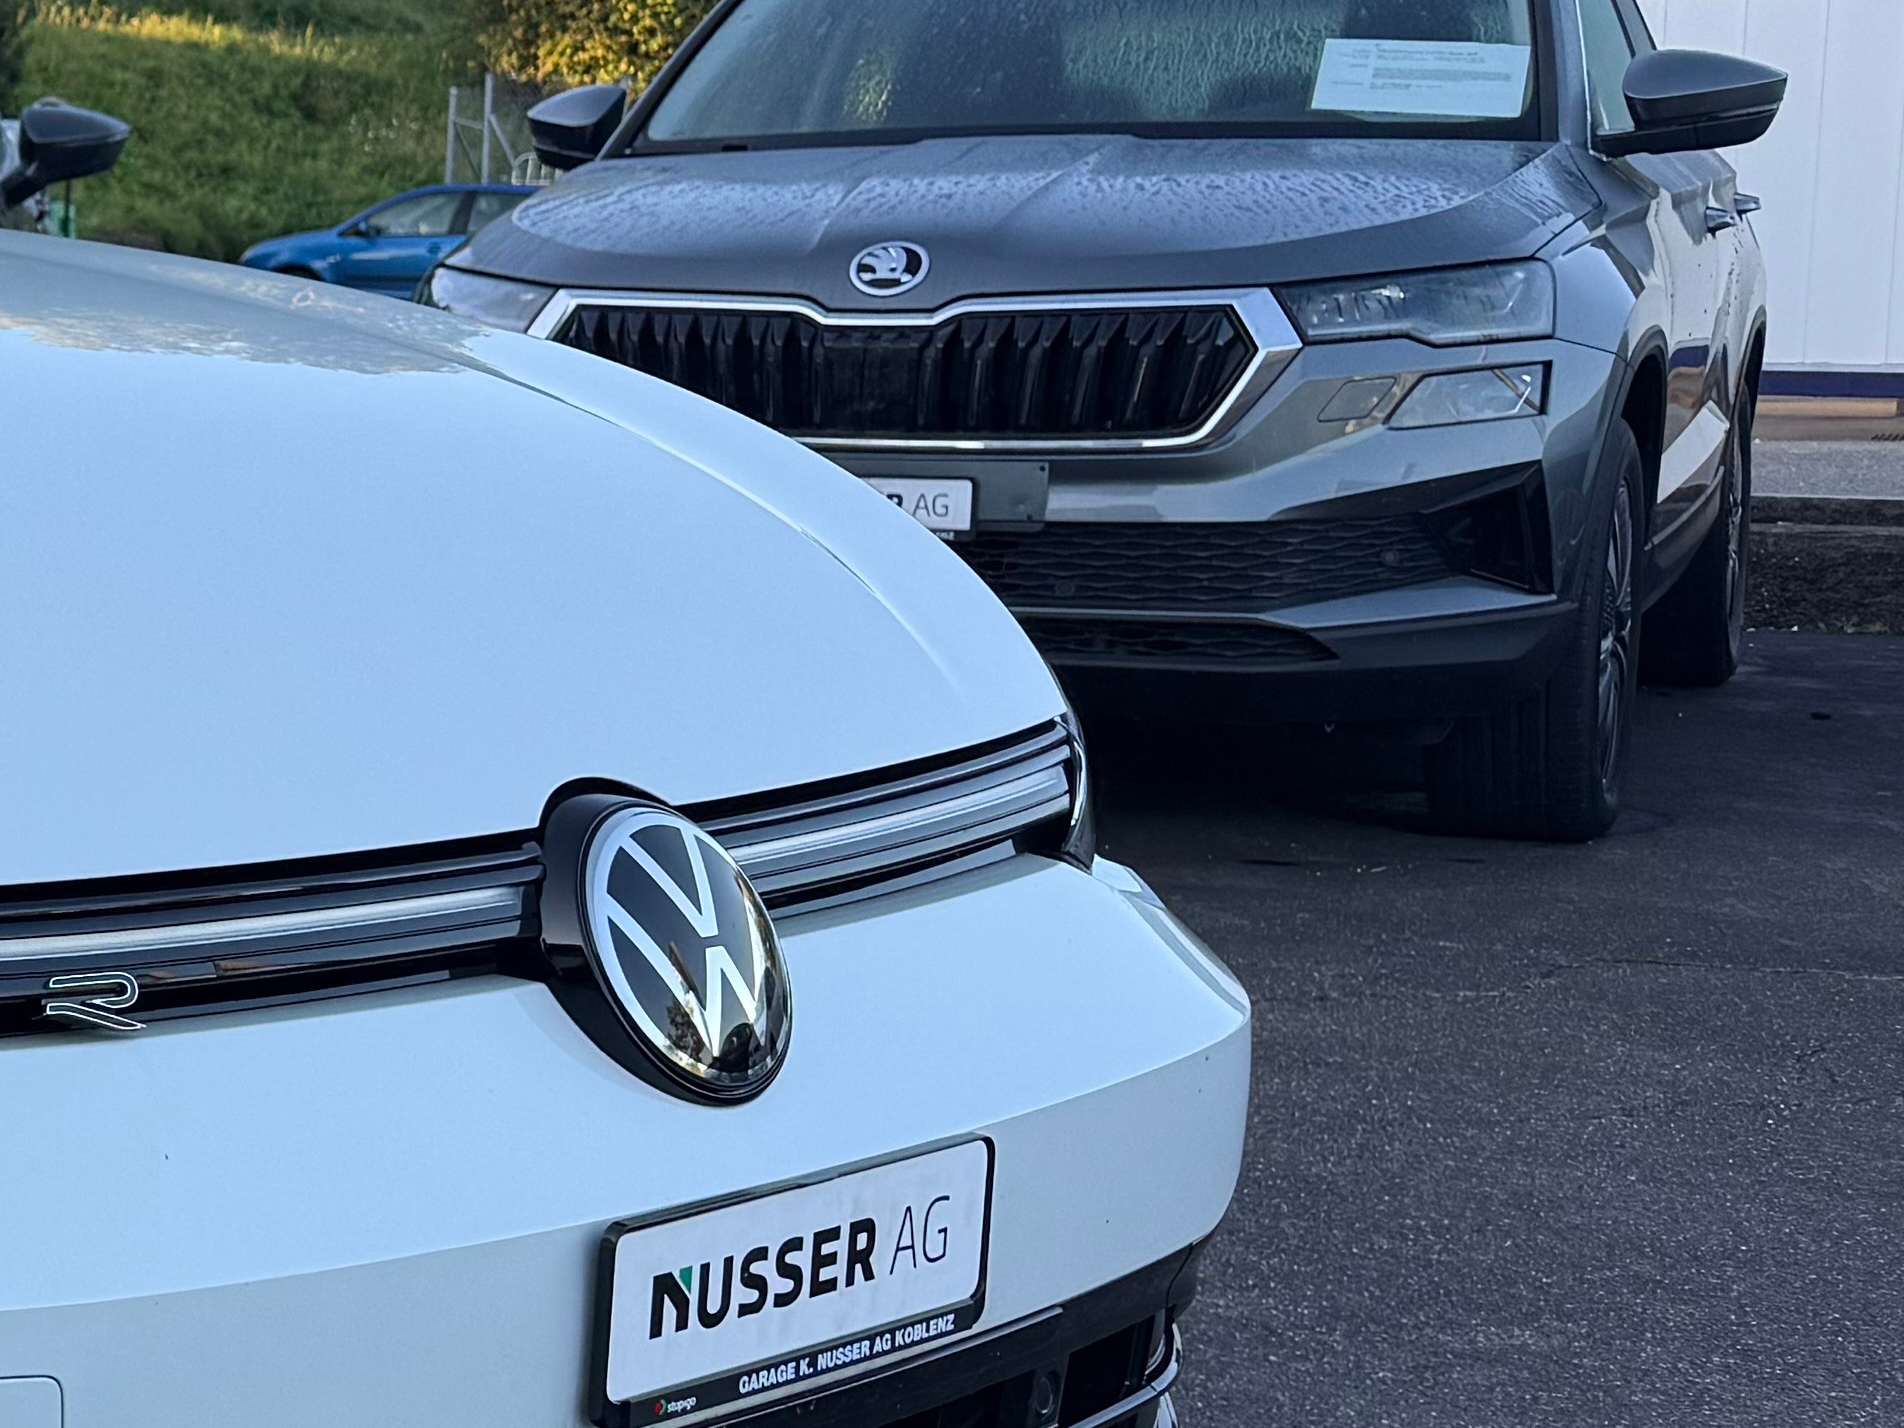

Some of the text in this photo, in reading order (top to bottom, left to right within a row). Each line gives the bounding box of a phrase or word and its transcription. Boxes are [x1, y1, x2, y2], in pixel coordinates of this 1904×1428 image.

[912, 493, 949, 518] AG
[43, 974, 146, 1031] R
[649, 1195, 950, 1340] NUSSER AG
[739, 1314, 955, 1394] GARAGE K. NUSSER AG KOBLENZ
